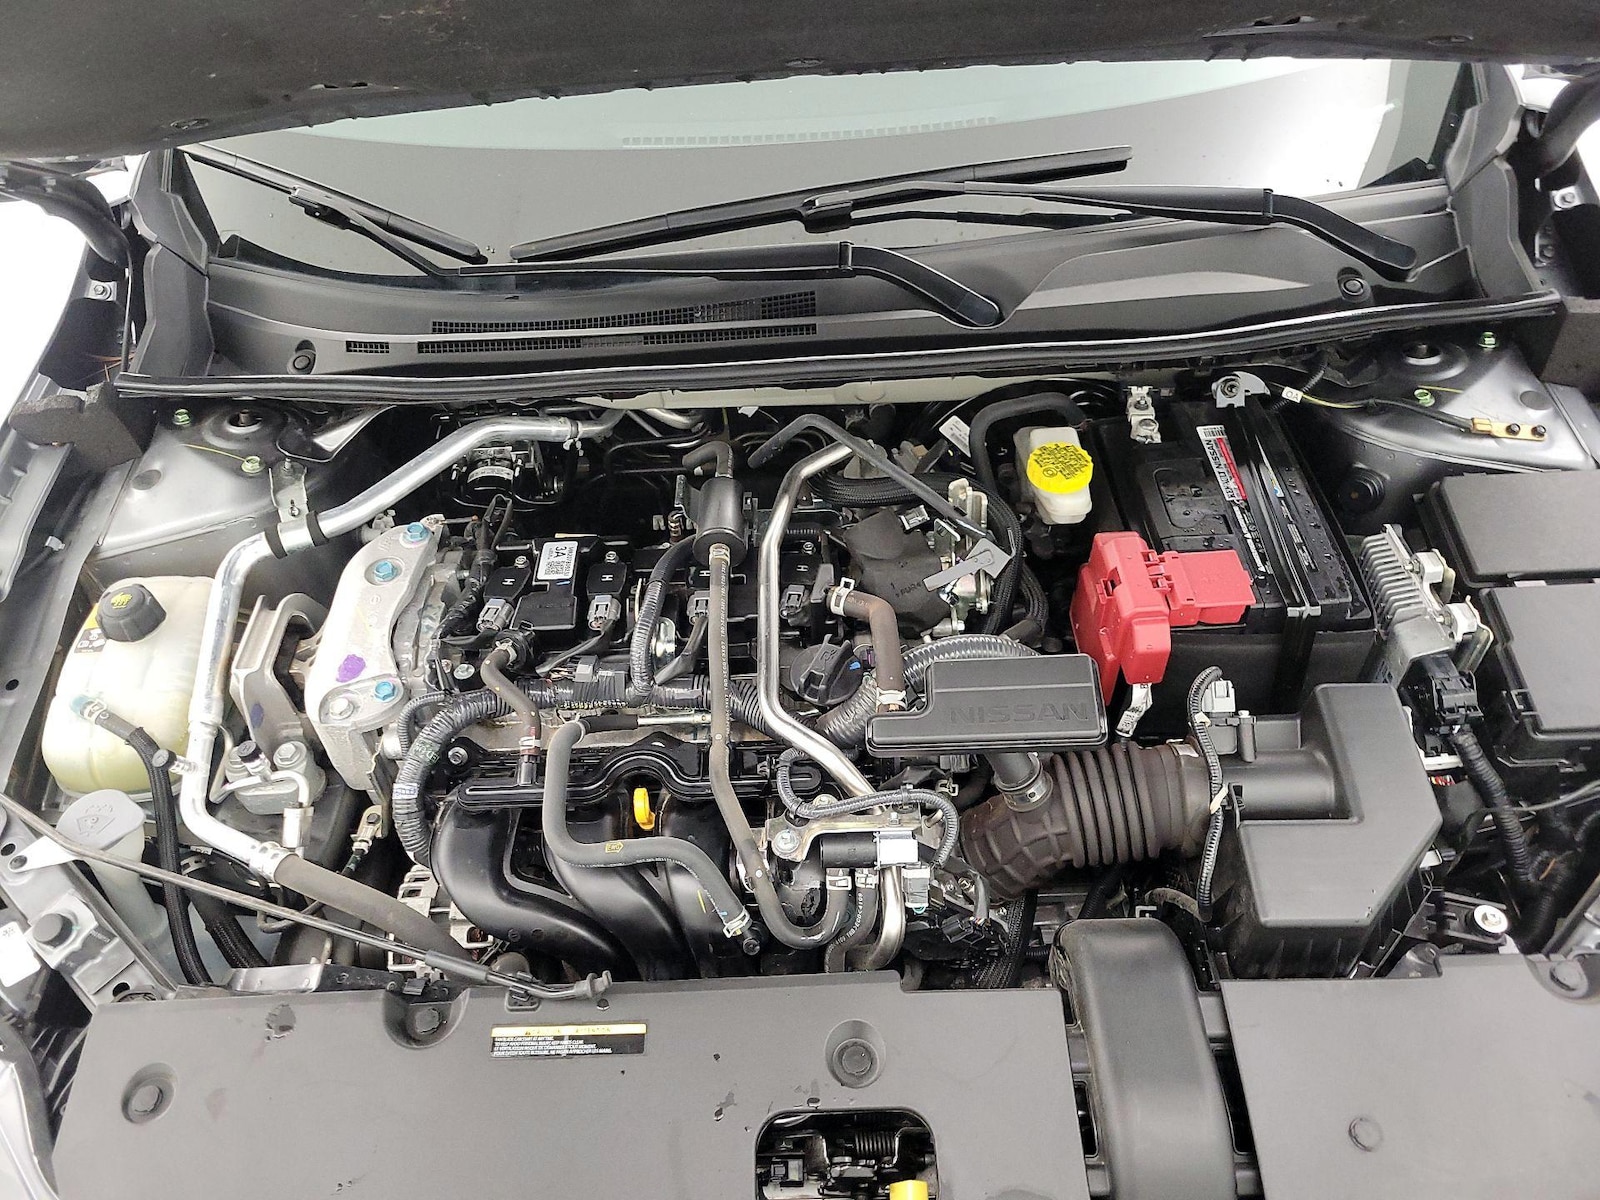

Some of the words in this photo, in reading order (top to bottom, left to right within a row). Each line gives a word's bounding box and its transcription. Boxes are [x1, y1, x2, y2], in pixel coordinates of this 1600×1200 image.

[1205, 439, 1222, 469] NISSAN
[553, 546, 567, 558] 3A
[950, 702, 1089, 724] NISSAN
